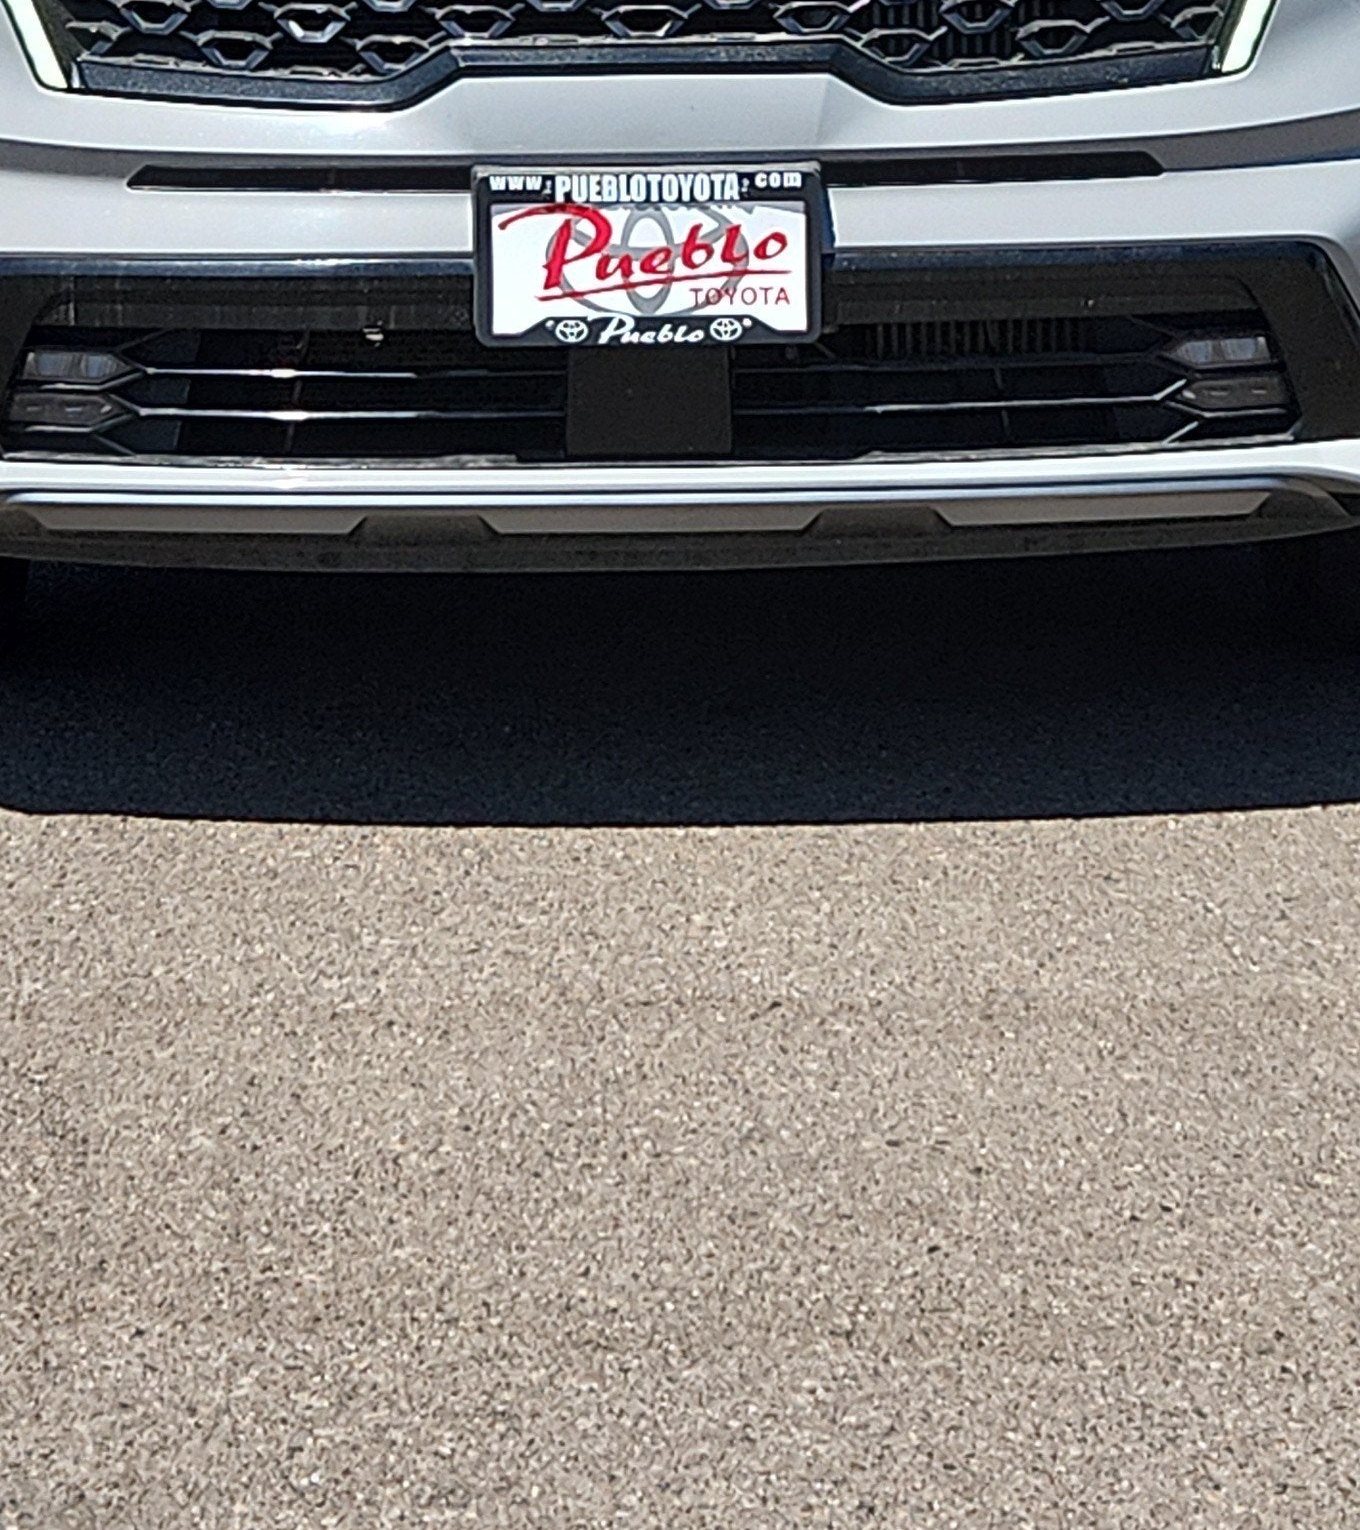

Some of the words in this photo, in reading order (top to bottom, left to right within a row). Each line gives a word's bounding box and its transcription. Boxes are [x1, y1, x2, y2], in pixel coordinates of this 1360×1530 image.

[498, 203, 788, 291] Pueblo
[690, 286, 791, 307] TOYOTA
[587, 315, 705, 346] Pueblo
